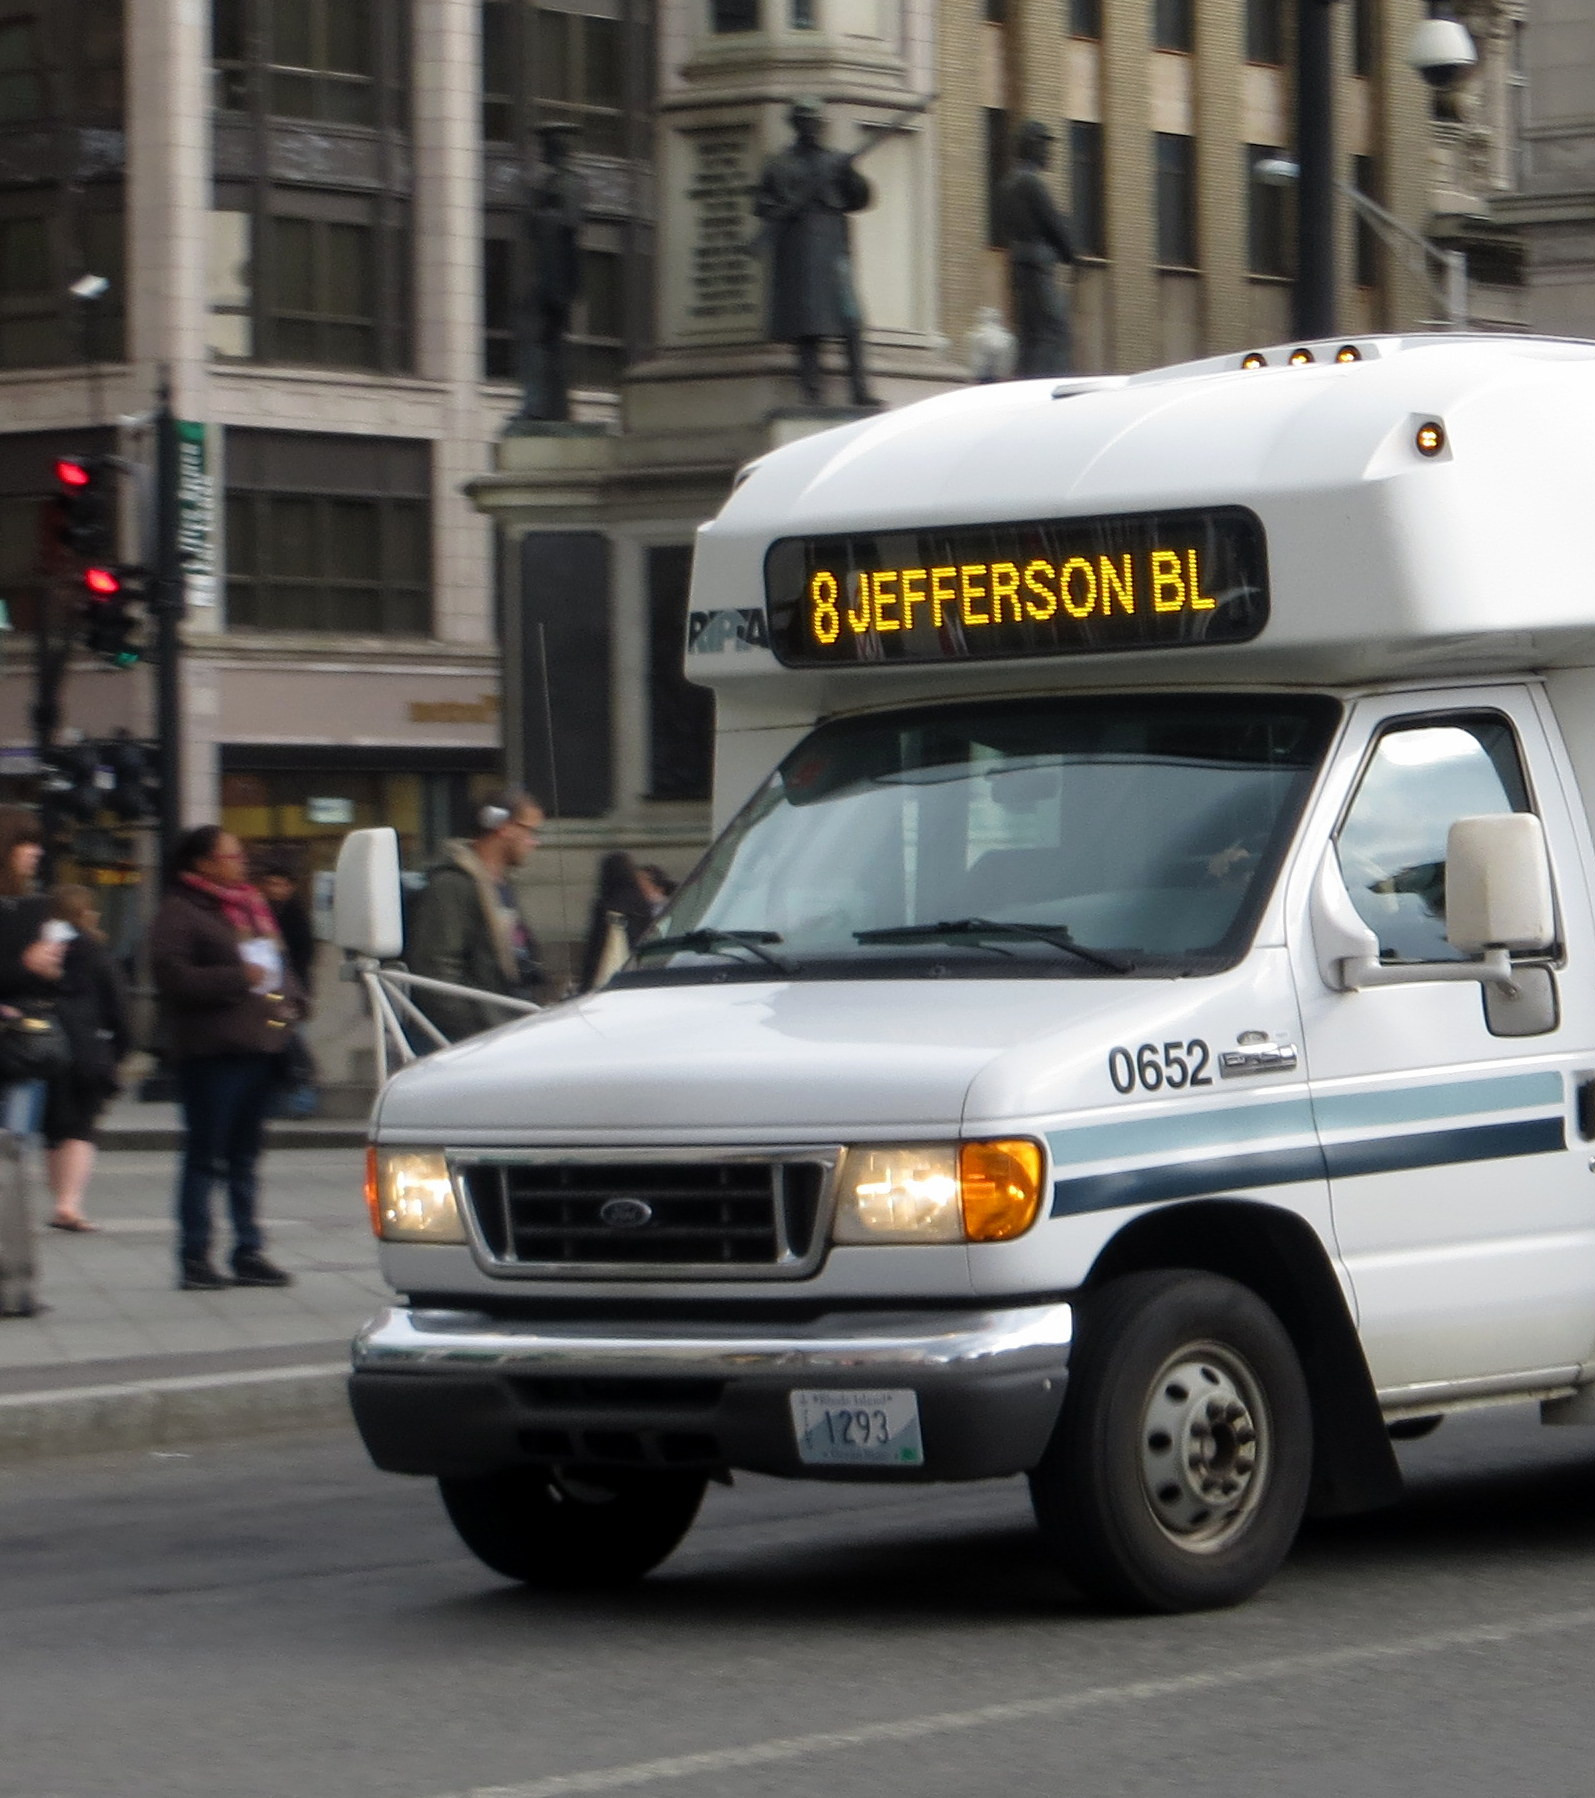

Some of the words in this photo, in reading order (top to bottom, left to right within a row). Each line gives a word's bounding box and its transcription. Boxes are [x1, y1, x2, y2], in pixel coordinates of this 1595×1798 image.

[811, 570, 840, 644] 8
[847, 553, 1134, 634] JEFFERSON
[1151, 549, 1215, 613] BL
[1108, 1038, 1213, 1095] 0652
[824, 1409, 889, 1444] 1293
